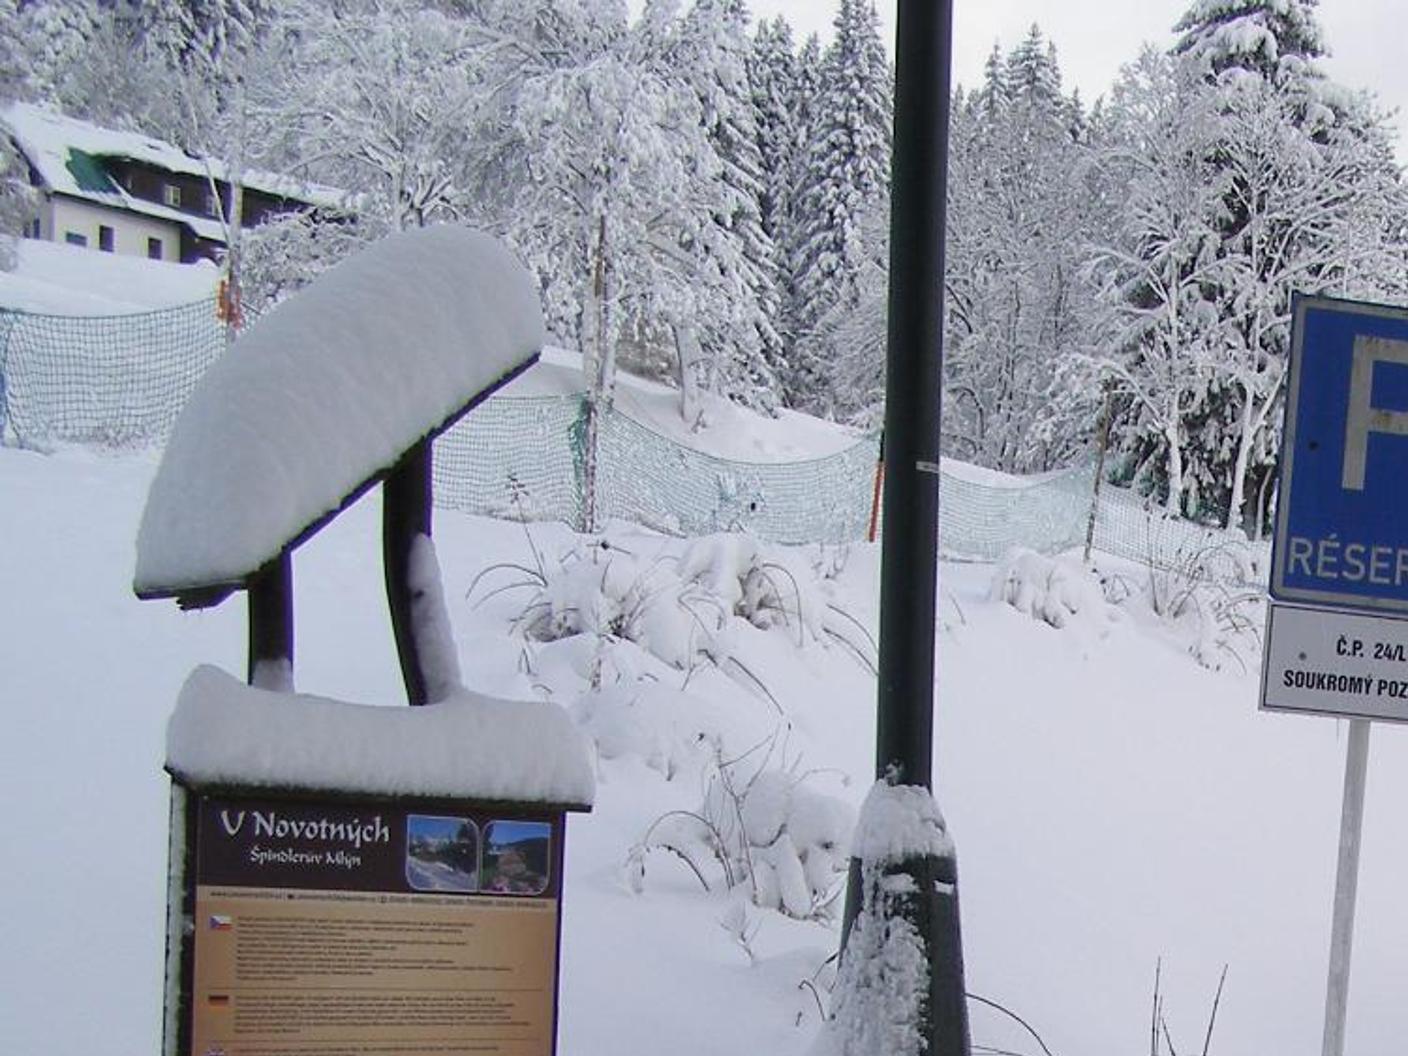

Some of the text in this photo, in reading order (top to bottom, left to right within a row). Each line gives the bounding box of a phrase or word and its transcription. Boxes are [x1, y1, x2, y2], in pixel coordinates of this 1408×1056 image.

[1336, 634, 1364, 657] Č.P.
[1283, 669, 1374, 695] SOUKROMÝ
[220, 810, 391, 848] V Novotných
